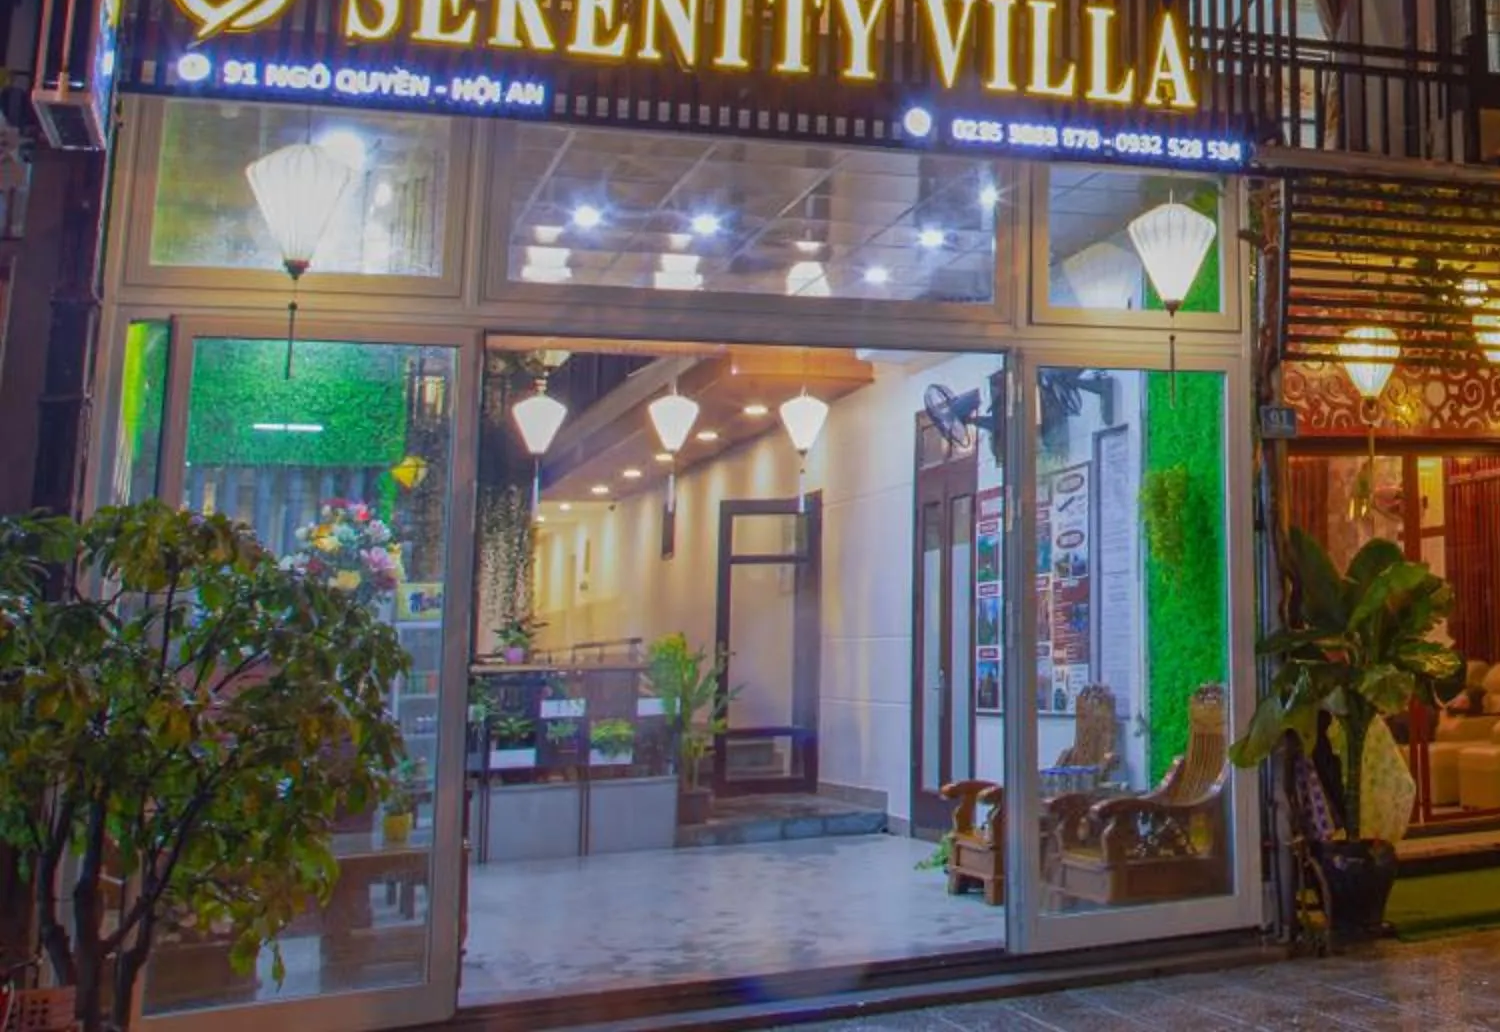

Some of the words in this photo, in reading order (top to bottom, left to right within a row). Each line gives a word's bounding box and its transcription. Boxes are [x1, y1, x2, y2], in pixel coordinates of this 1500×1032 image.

[222, 59, 257, 86] 91
[264, 62, 330, 90] NGÔ
[505, 81, 545, 106] AN
